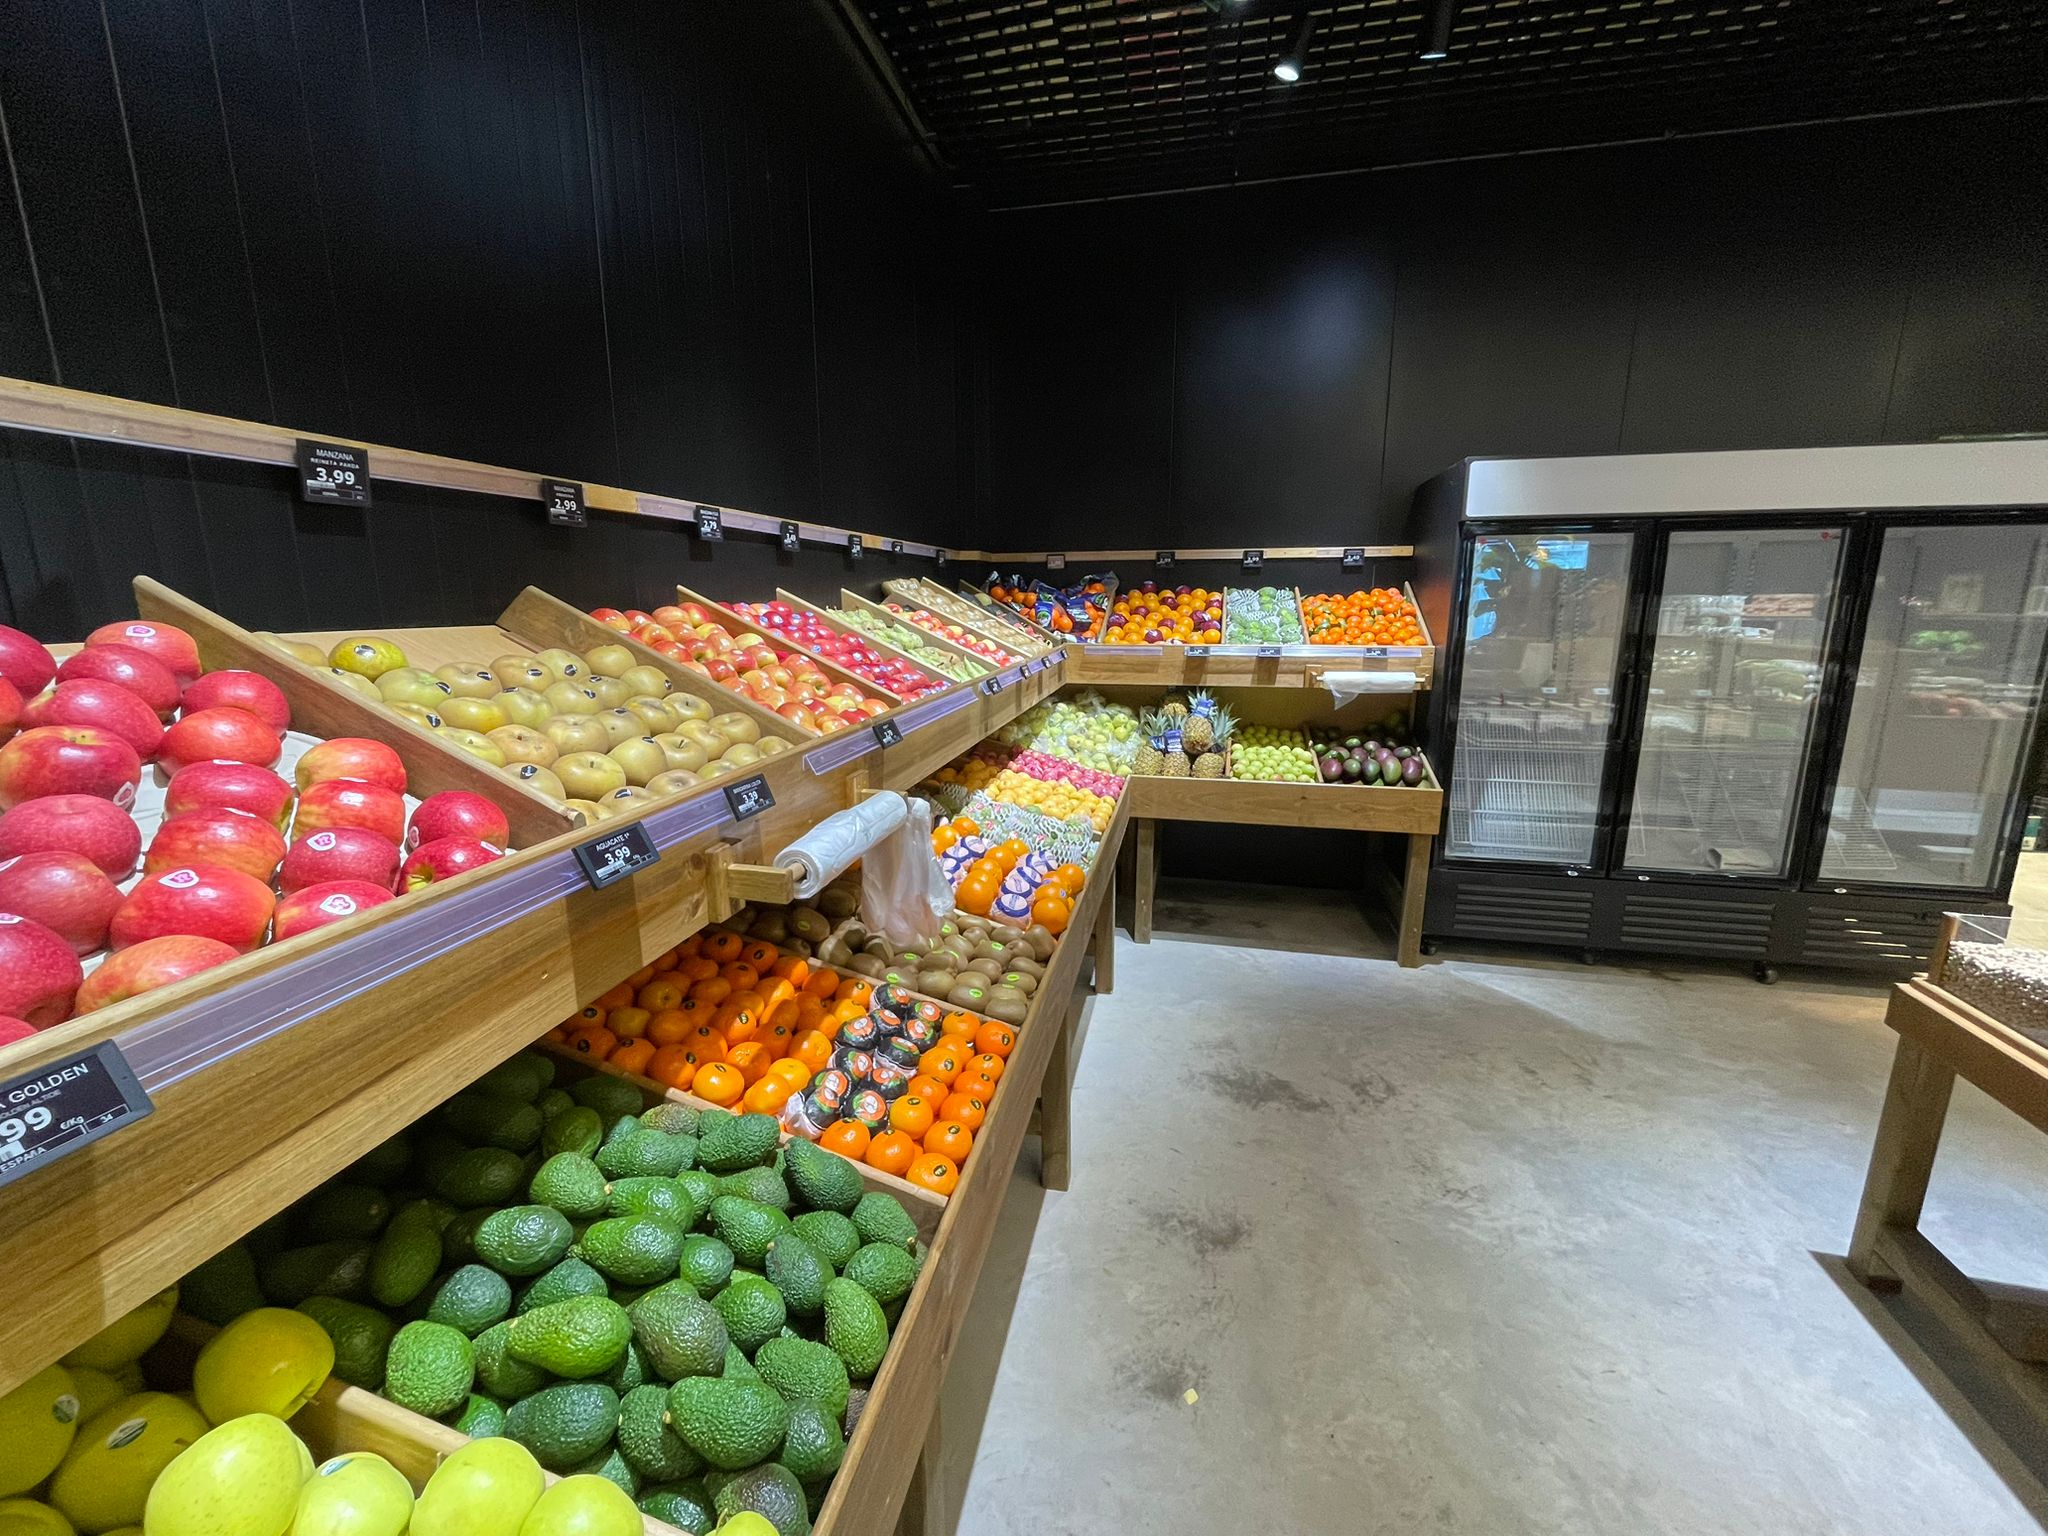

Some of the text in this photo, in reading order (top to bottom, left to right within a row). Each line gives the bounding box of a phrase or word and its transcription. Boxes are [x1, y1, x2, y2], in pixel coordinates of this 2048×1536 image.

[316, 449, 354, 461] MANZANA
[316, 467, 355, 485] 3.99
[555, 498, 576, 510] 2.99
[742, 790, 758, 804] 3.39
[596, 835, 625, 851] AGUACATE
[604, 846, 631, 865] 3.99
[8, 1062, 89, 1103] GOLDEN
[60, 1113, 114, 1130] €/Kg 34
